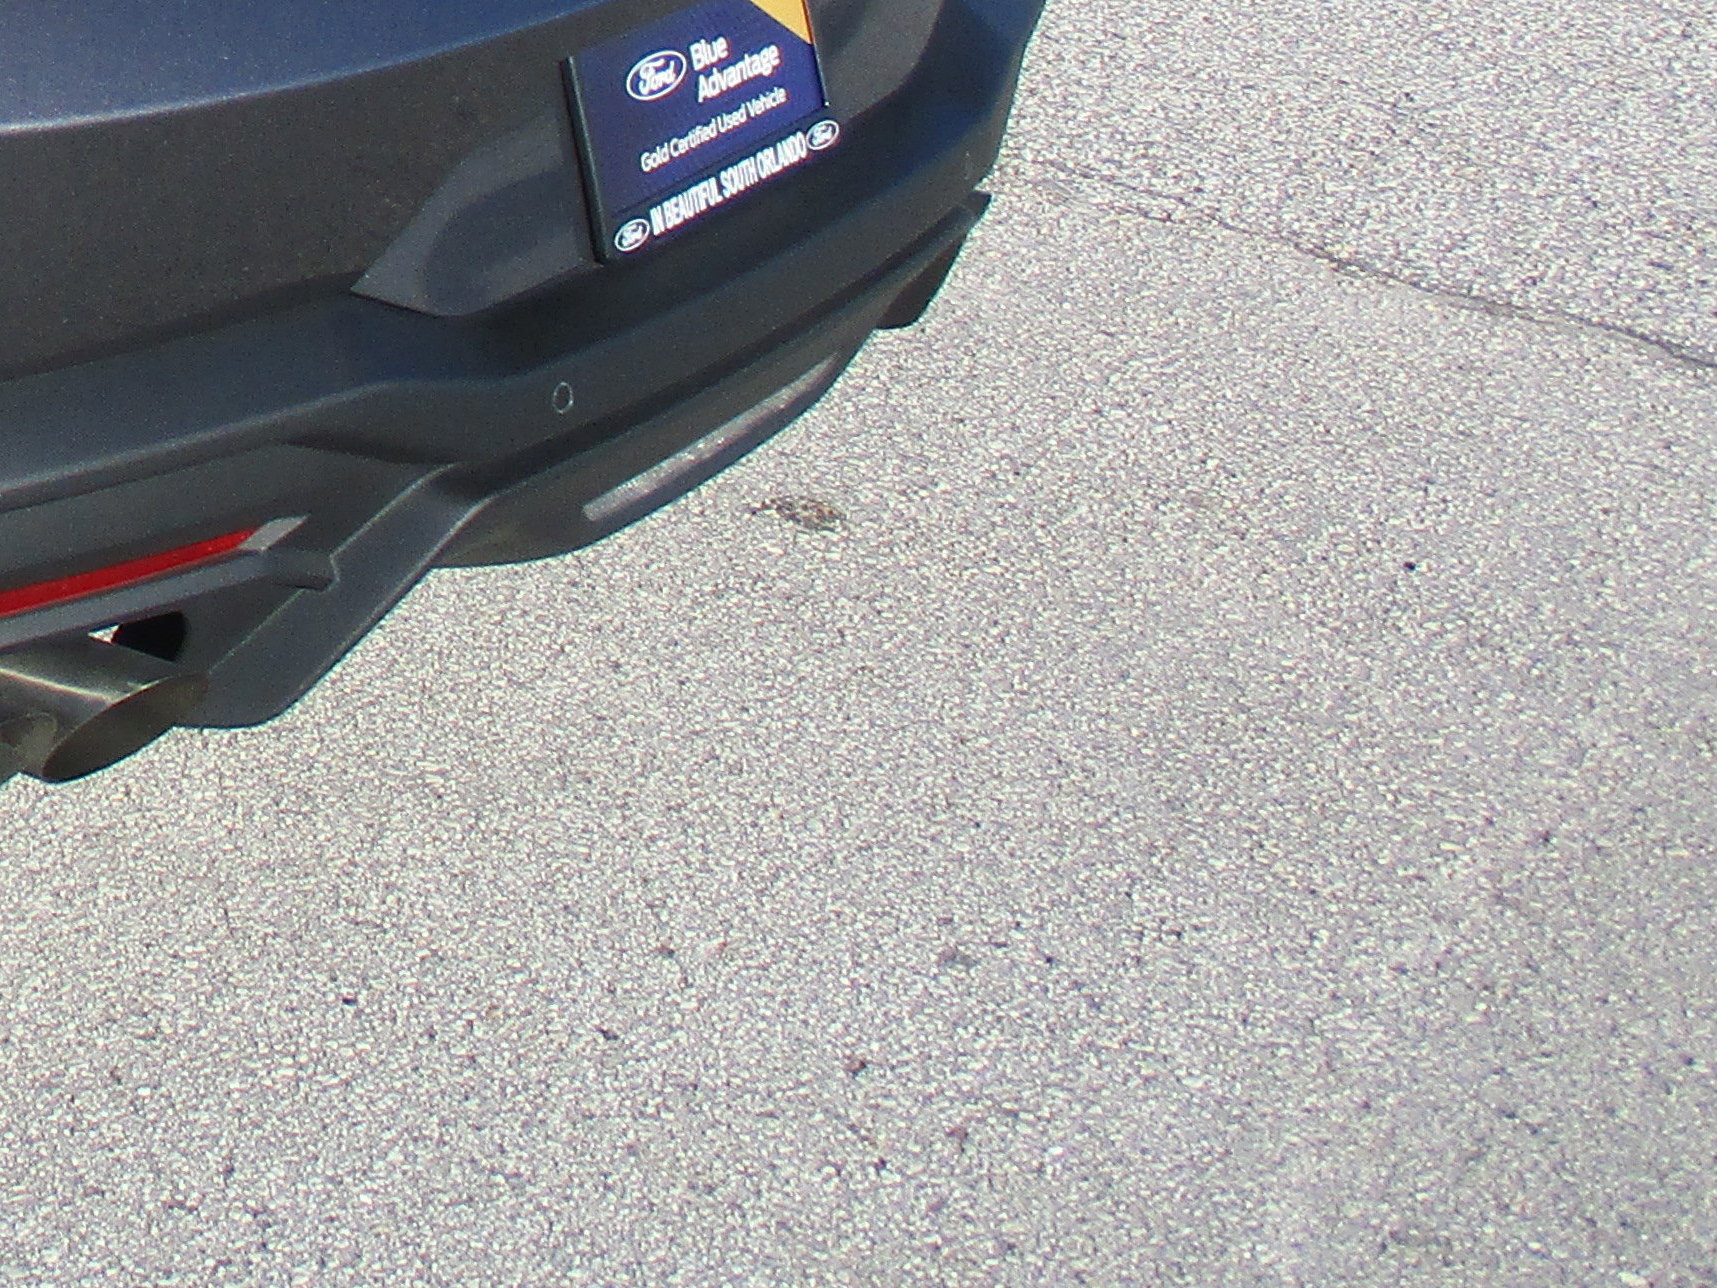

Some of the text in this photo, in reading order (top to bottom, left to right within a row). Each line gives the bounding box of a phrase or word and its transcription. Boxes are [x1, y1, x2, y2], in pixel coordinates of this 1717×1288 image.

[689, 36, 730, 71] Blue
[698, 44, 781, 103] Advantage
[640, 87, 788, 173] Gold Certified Used Vehicle
[649, 131, 808, 235] IN BEAUTIFUL SOUTH ORLANDO
